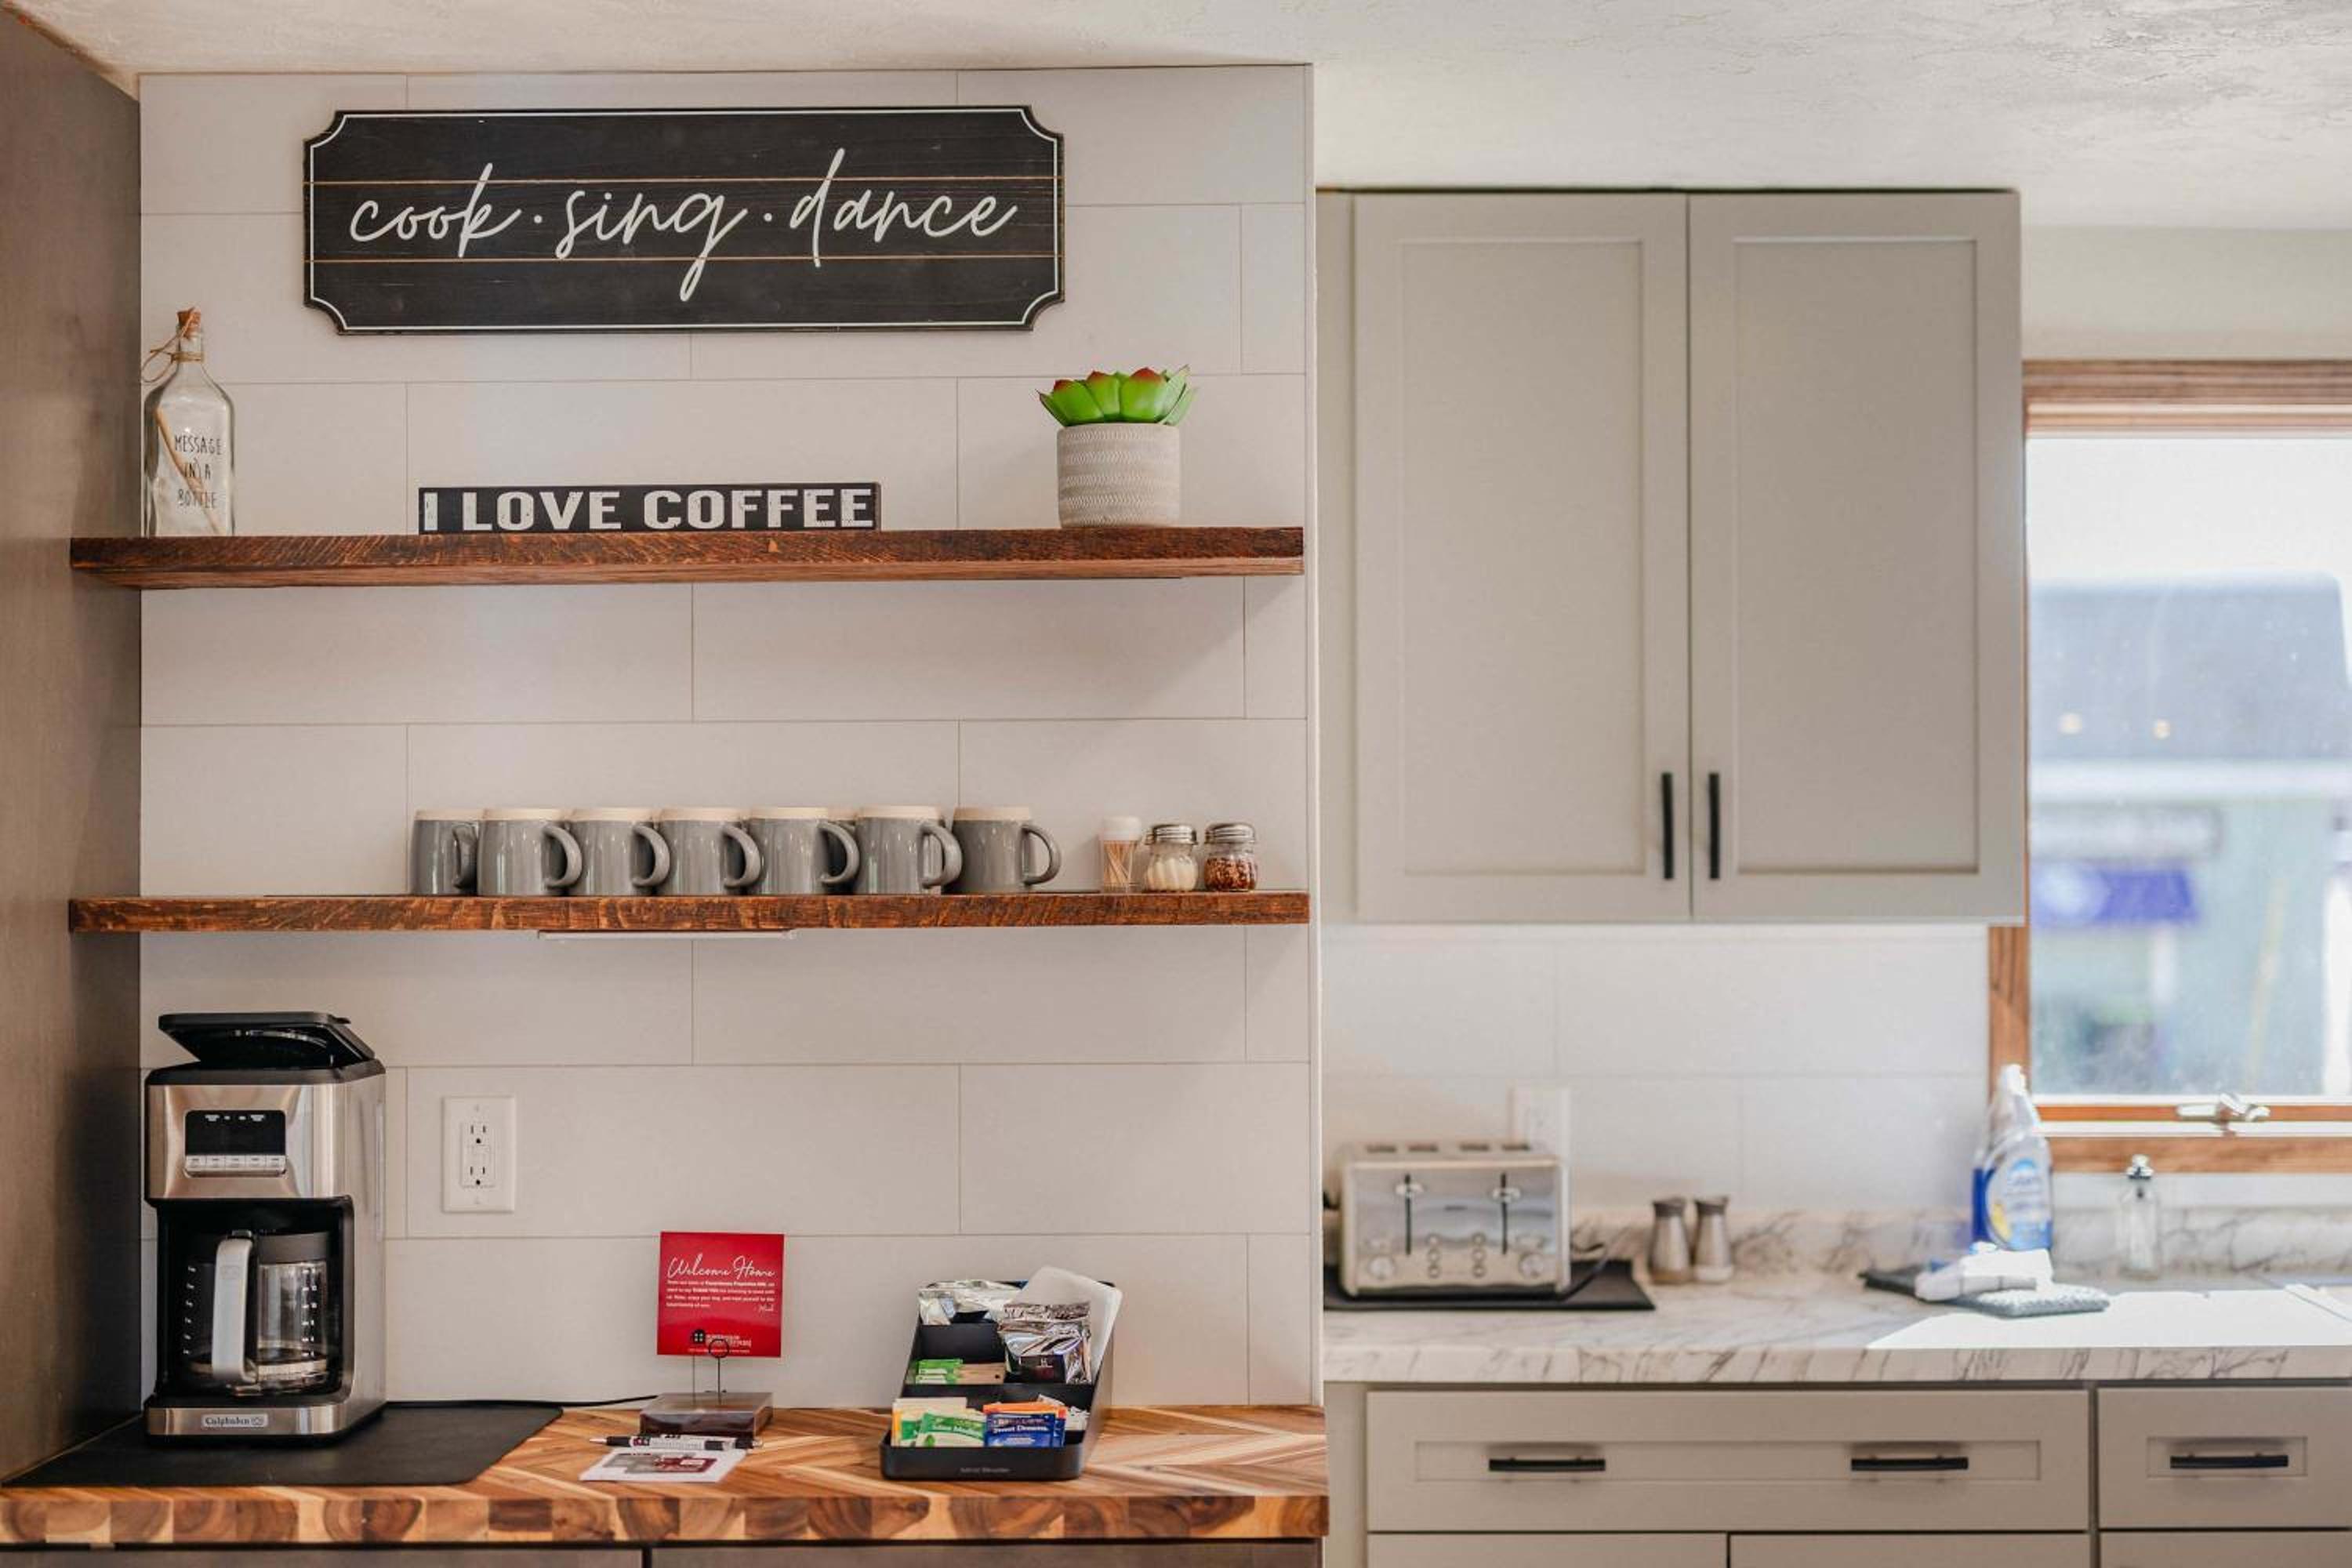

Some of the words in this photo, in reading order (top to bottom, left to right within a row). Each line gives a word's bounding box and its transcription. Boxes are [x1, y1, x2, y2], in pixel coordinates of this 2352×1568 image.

[350, 162, 521, 258] cook
[554, 188, 748, 302] sing
[789, 147, 1018, 268] dance
[175, 434, 222, 456] MESSAGE
[178, 488, 218, 509] BOTTLE
[423, 492, 437, 530] I
[463, 491, 622, 530] LOVE
[643, 488, 873, 529] COFFEE
[666, 1252, 731, 1279] Welcome
[732, 1255, 775, 1279] Home
